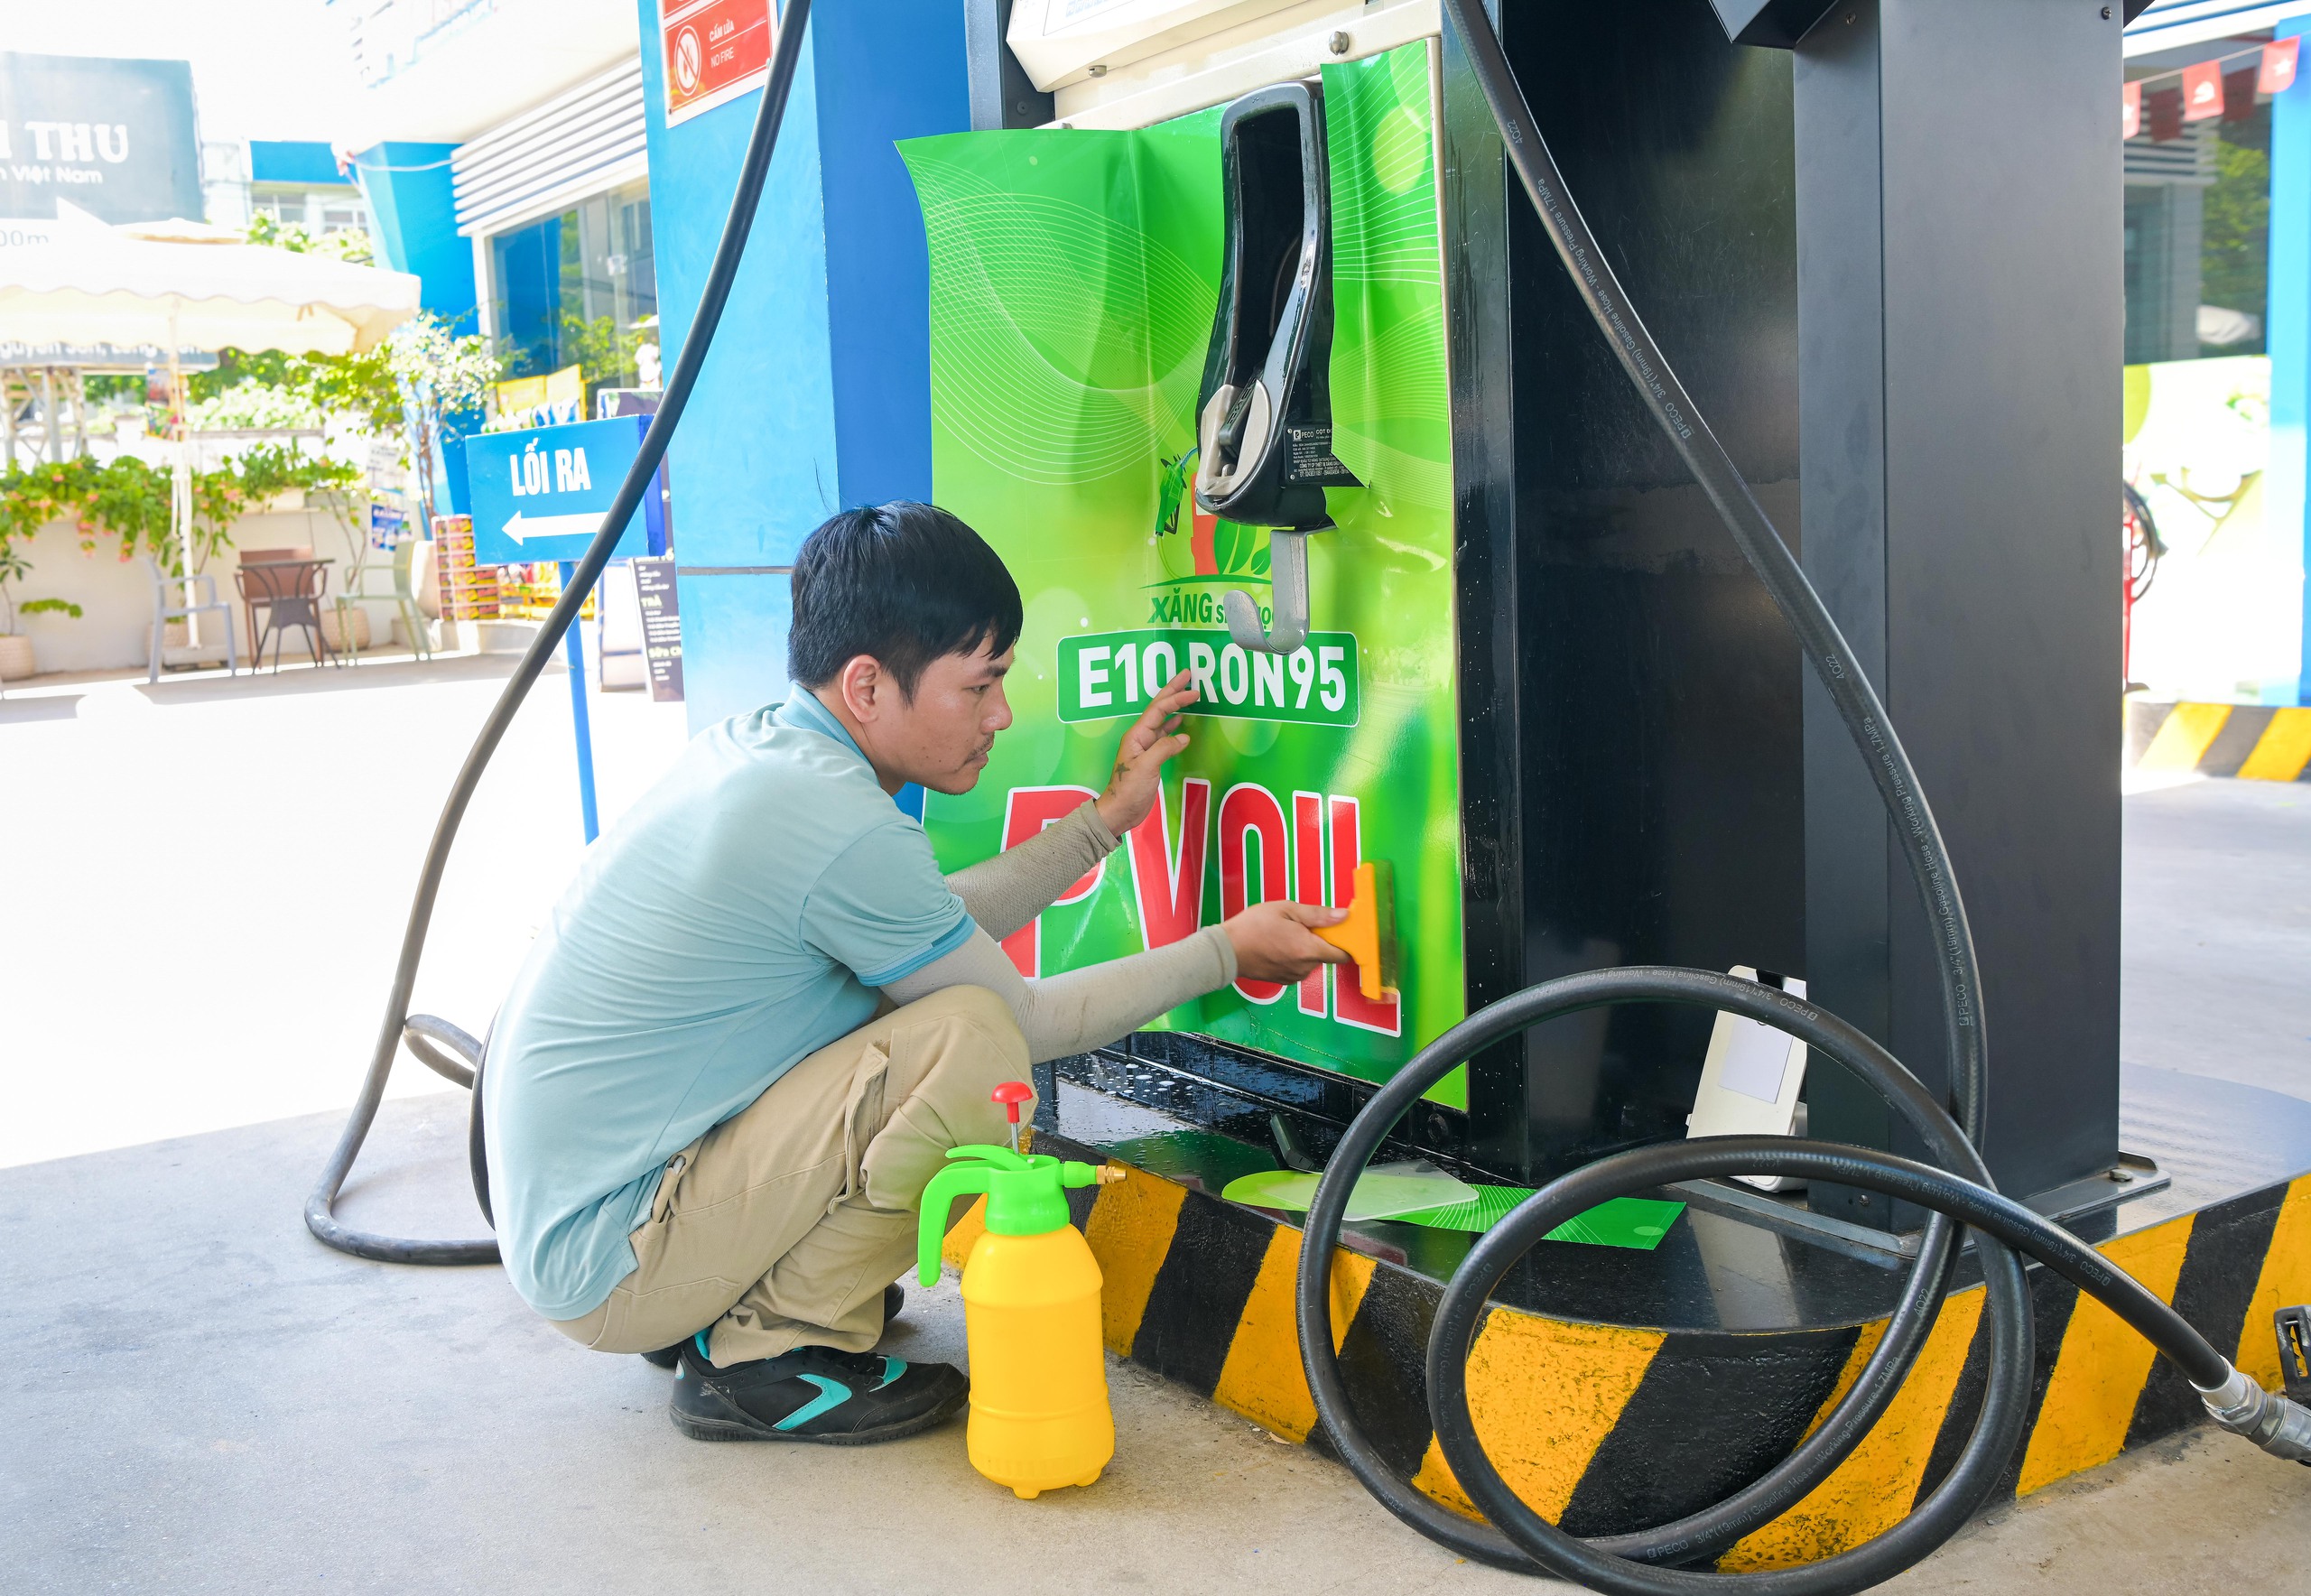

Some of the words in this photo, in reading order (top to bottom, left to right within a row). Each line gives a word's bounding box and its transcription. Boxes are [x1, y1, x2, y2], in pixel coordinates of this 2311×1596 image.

[710, 54, 720, 69] NO
[720, 46, 734, 63] FIRE
[24, 121, 128, 163] THU
[1508, 119, 1523, 144] 4Q22
[10, 165, 51, 185] Việt
[55, 166, 103, 183] Nam
[1537, 178, 1557, 212] 1.7MPa
[1555, 211, 1578, 251] Pressure
[1575, 248, 1598, 287] Working
[1598, 290, 1614, 315] Hose
[1611, 312, 1635, 351] Gasoline
[1666, 403, 1687, 431] PECO
[510, 437, 550, 496] LỐI
[554, 447, 591, 493] RA
[1147, 588, 1212, 624] XĂNG
[1079, 642, 1176, 709] E10
[1826, 654, 1845, 679] 4Q22
[1863, 716, 1885, 753] 1.7MPa
[1882, 754, 1906, 797] Pressure
[1902, 796, 1923, 839] Working
[1921, 844, 1935, 871] Hose
[1930, 872, 1949, 915] Gasoline
[1607, 970, 1643, 979] Working
[1652, 970, 1675, 978] Hose
[1677, 971, 1718, 985] Gasoline
[1779, 998, 1807, 1016] PECO
[1956, 984, 1969, 1015] PECO
[1921, 1182, 1962, 1206] Working
[1992, 1211, 2030, 1238] Gasoline
[1657, 1539, 1689, 1557] PECO
[1750, 1484, 1791, 1517] Gasoline
[1788, 1467, 1814, 1488] Hose
[1814, 1428, 1851, 1466] Working
[1845, 1391, 1879, 1434] Pressure
[1913, 1288, 1930, 1316] 4Q22
